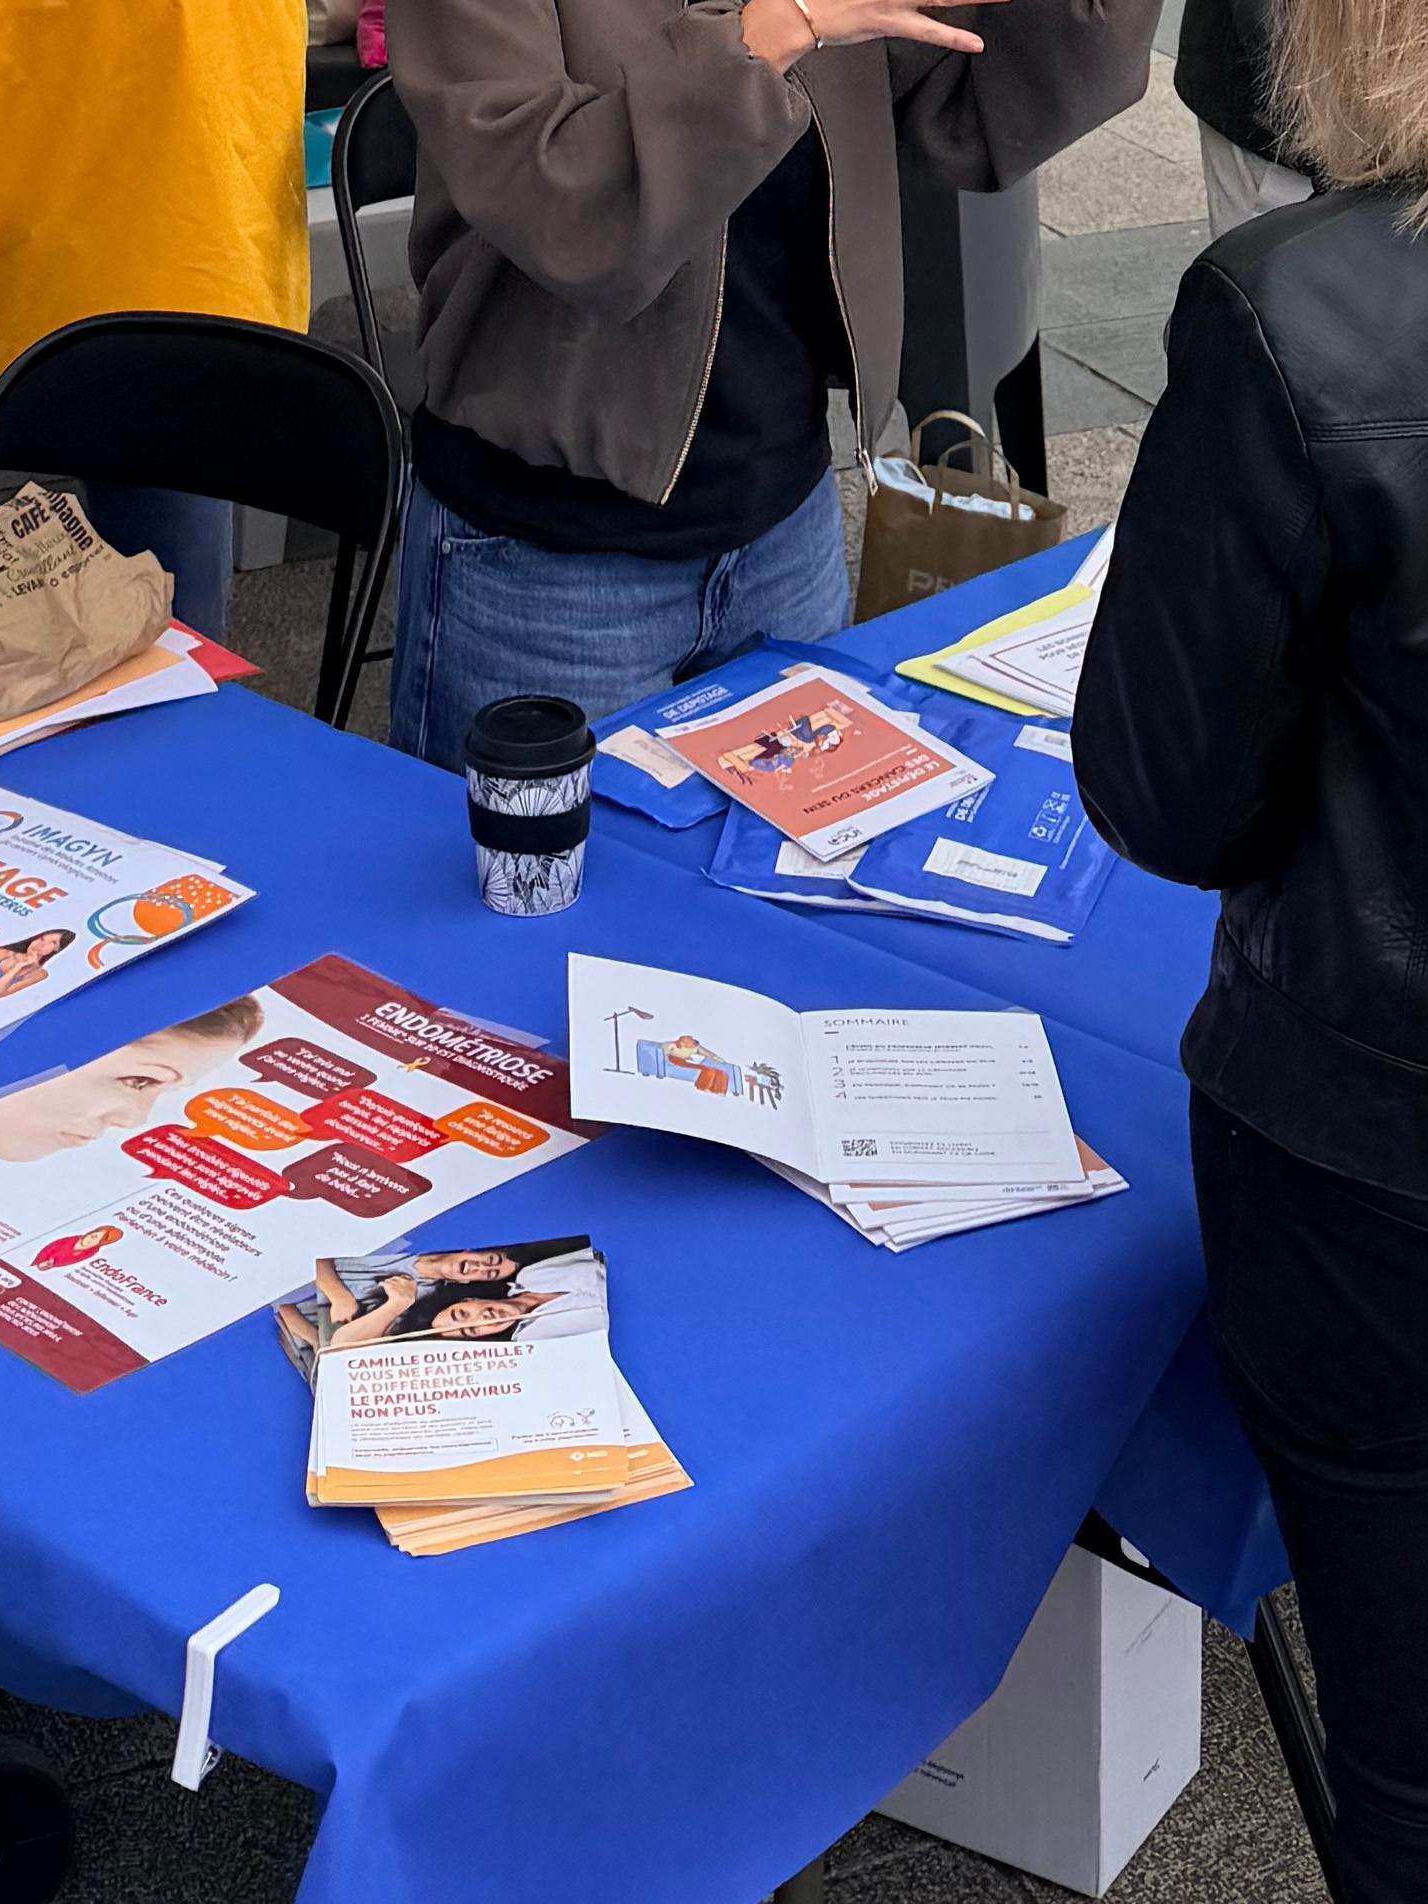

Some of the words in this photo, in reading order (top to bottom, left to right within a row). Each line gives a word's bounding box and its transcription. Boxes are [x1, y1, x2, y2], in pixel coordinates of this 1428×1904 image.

[44, 491, 93, 552] mpagne
[920, 759, 943, 772] LE
[845, 763, 909, 795] CANCERS
[827, 789, 852, 803] DU
[22, 823, 123, 867] IMAGYN
[823, 1017, 910, 1029] SOMMAIRE
[373, 1000, 553, 1090] ENDOMÉTRIOSE
[110, 1210, 161, 1238] Parlez-en
[123, 1205, 142, 1215] ou
[135, 1211, 170, 1230] d'une
[136, 1198, 170, 1217] d'une
[161, 1212, 233, 1253] endométriose
[148, 1193, 194, 1218] peuvent
[186, 1214, 213, 1228] être
[206, 1224, 265, 1258] révélateurs
[161, 1186, 186, 1200] Ces
[178, 1196, 228, 1225] quelques
[219, 1220, 258, 1242] signes
[153, 1235, 168, 1243] à
[160, 1239, 194, 1257] votre
[185, 1253, 234, 1280] médecin
[225, 1274, 240, 1282] !
[86, 1256, 173, 1308] EndoFrance
[348, 1352, 420, 1370] CAMILLE
[423, 1351, 448, 1365] OU
[452, 1345, 523, 1363] CAMILLE
[525, 1344, 535, 1357] ?
[348, 1367, 394, 1384] VOUS
[397, 1365, 421, 1380] NE
[424, 1361, 482, 1378] FAITES
[487, 1357, 519, 1373] PAS
[349, 1381, 371, 1396] LA
[371, 1372, 479, 1394] DIFFÉRENCE.
[350, 1395, 371, 1407] LE
[373, 1382, 523, 1407] PAPILLOMAVIRUS
[351, 1405, 391, 1420] NON
[393, 1403, 441, 1418] PLUS.
